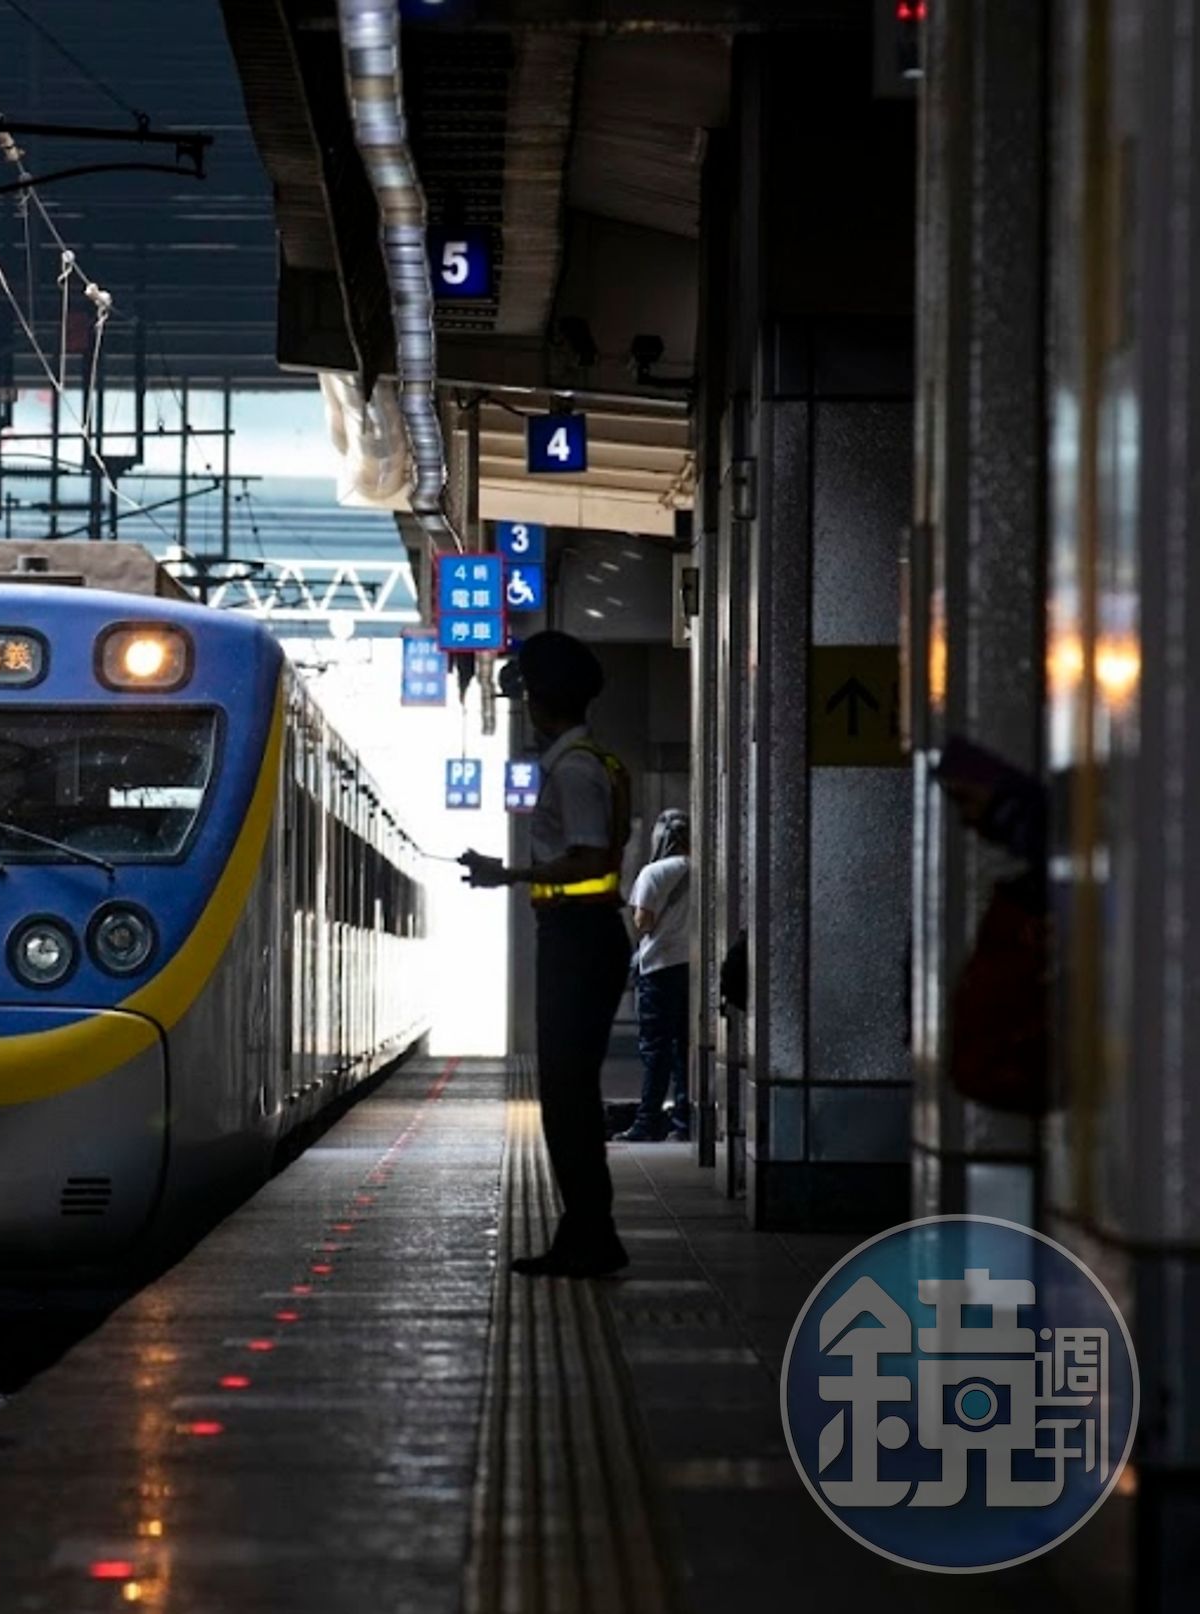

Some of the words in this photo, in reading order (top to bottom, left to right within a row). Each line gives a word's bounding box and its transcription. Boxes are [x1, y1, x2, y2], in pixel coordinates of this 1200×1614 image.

[440, 240, 470, 285] 5
[547, 427, 570, 461] 4
[511, 524, 529, 552] 3
[451, 761, 476, 785] PP
